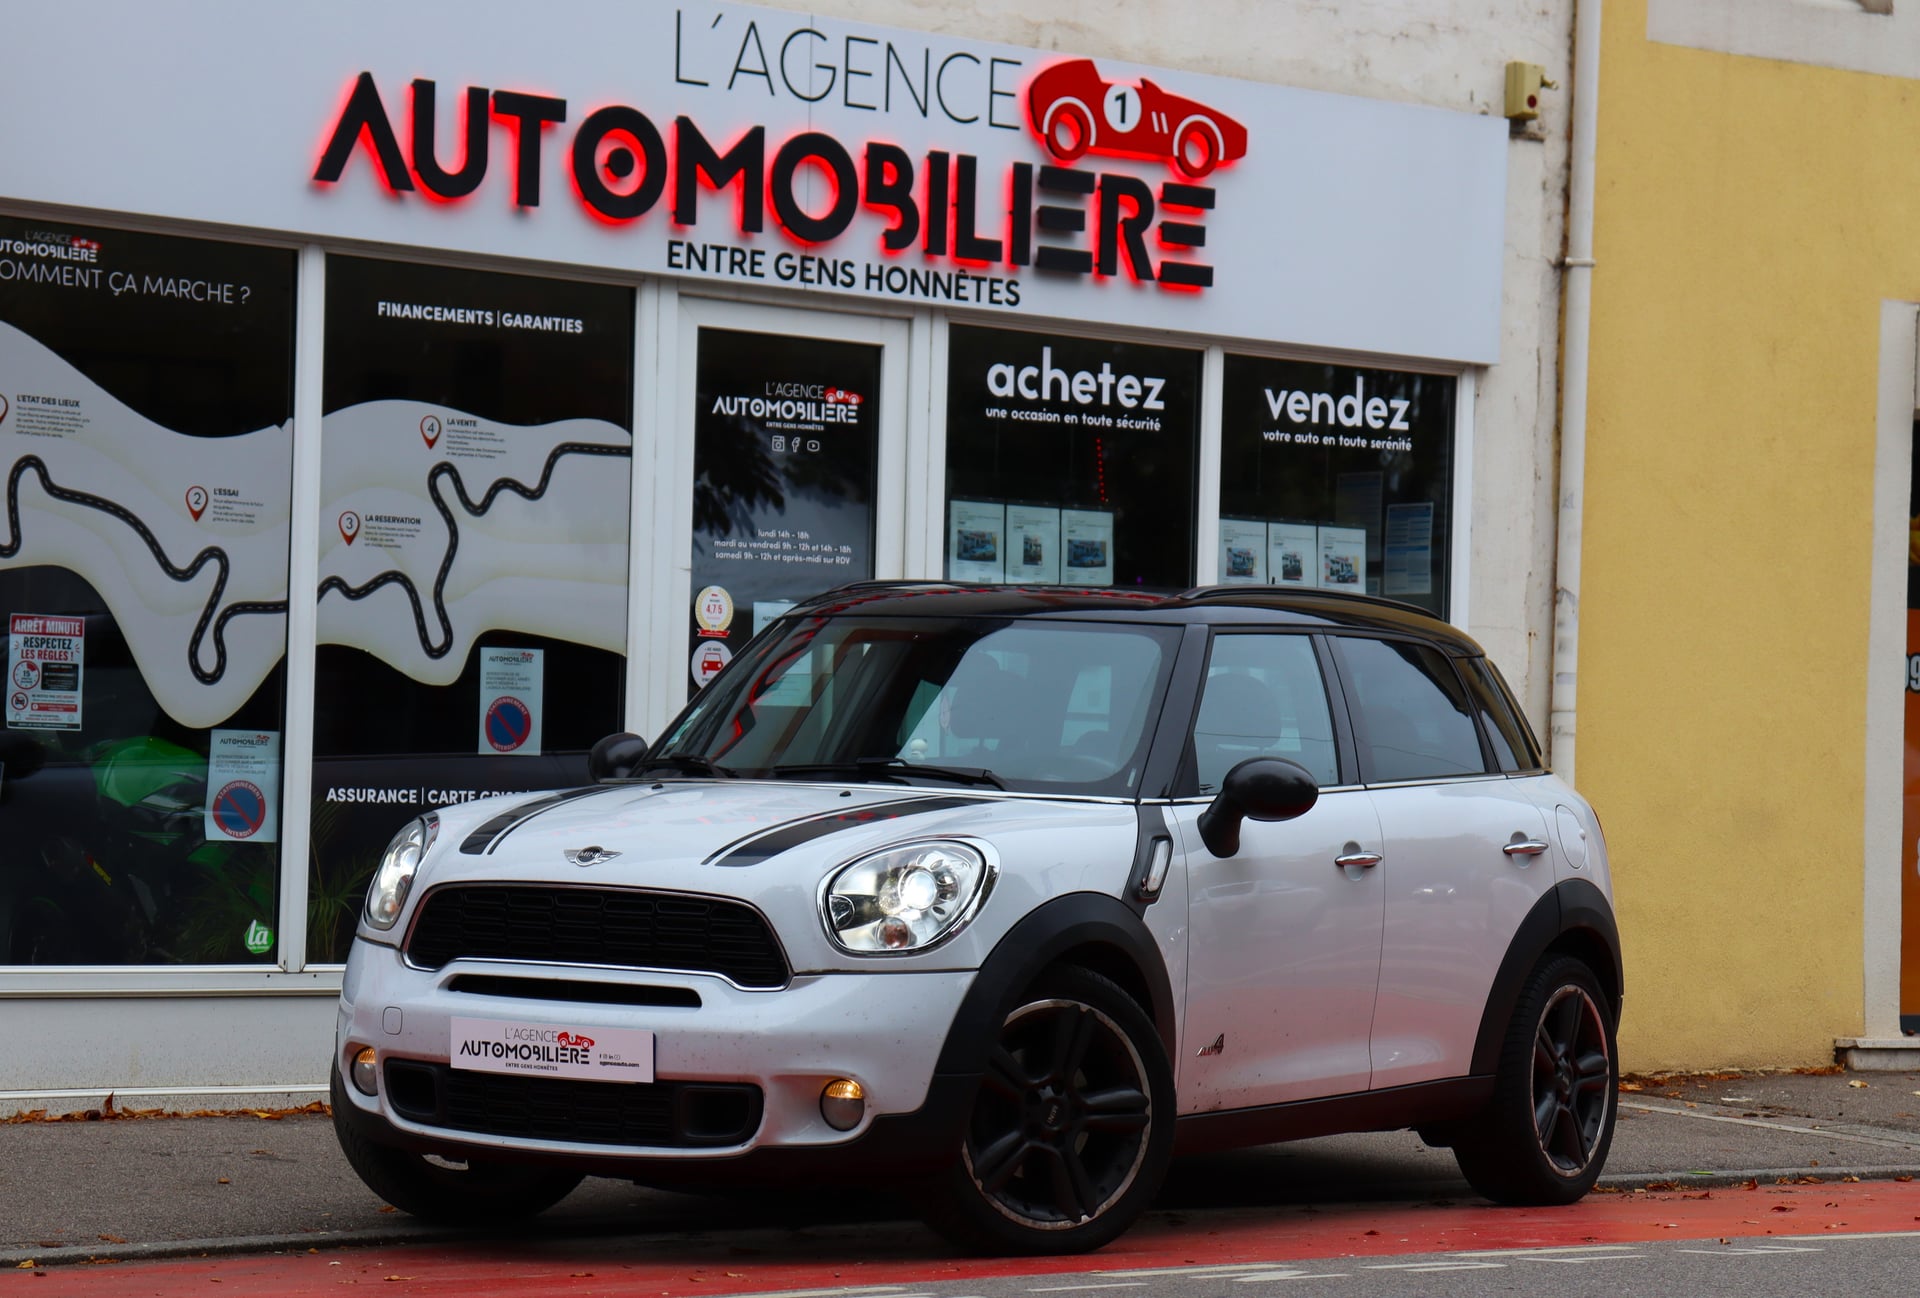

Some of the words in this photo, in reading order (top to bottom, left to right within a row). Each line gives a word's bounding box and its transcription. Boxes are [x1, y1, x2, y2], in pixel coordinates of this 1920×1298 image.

[0, 239, 97, 262] TOMOBILIERE
[667, 241, 766, 278] ENTRE
[774, 251, 855, 288] GENS
[866, 263, 1020, 307] HONNÊTES
[0, 260, 103, 289] OMMENT
[109, 272, 137, 296] ÇA
[144, 275, 234, 304] MARCHE
[378, 302, 494, 325] FINANCEMENTS
[502, 313, 583, 333] GARANTIES
[987, 346, 1166, 410] achetez
[766, 382, 824, 399] L'AGENCE
[41, 397, 56, 405] DES
[58, 399, 80, 408] LIEUX
[1264, 376, 1410, 431] vendez
[456, 419, 477, 427] VENTE
[985, 407, 1007, 418] une
[1011, 408, 1060, 423] occasion
[1064, 414, 1078, 424] en
[1082, 412, 1113, 427] toute
[1116, 414, 1161, 431] sécurité
[427, 422, 435, 433] 4
[1263, 430, 1291, 442] votre
[1294, 432, 1319, 444] auto
[1322, 435, 1336, 445] en
[1339, 434, 1367, 448] toute
[1370, 437, 1412, 451] serénité
[194, 492, 201, 505] 2
[214, 488, 239, 497] L'ESSAI
[346, 517, 353, 529] 3
[365, 514, 373, 522] LA
[375, 515, 421, 525] RESERVATION
[758, 529, 776, 538] lundi
[778, 530, 789, 538] 14h
[797, 531, 809, 540] 18h
[714, 539, 736, 548] mardi
[749, 540, 781, 550] vendredi
[782, 542, 791, 550] 9h
[799, 543, 810, 551] 12h
[812, 544, 819, 552] et
[820, 544, 832, 553] 14h
[840, 545, 852, 554] 18h
[715, 551, 742, 560] samedi
[744, 552, 753, 560] 9h
[760, 552, 772, 561] 12h
[773, 553, 781, 561] et
[782, 554, 822, 564] après-midi
[835, 555, 850, 565] RDV
[14, 618, 44, 633] ARRÊT
[46, 620, 81, 635] MINUTE
[23, 637, 73, 650] RESPECTEZ
[21, 649, 35, 659] LES
[37, 649, 69, 661] RÈGLES
[218, 782, 262, 800] STATIONNEMENT
[326, 787, 417, 804] ASSURANCE
[225, 828, 253, 837] INTERDIT
[505, 1027, 558, 1043] L'AGENCE
